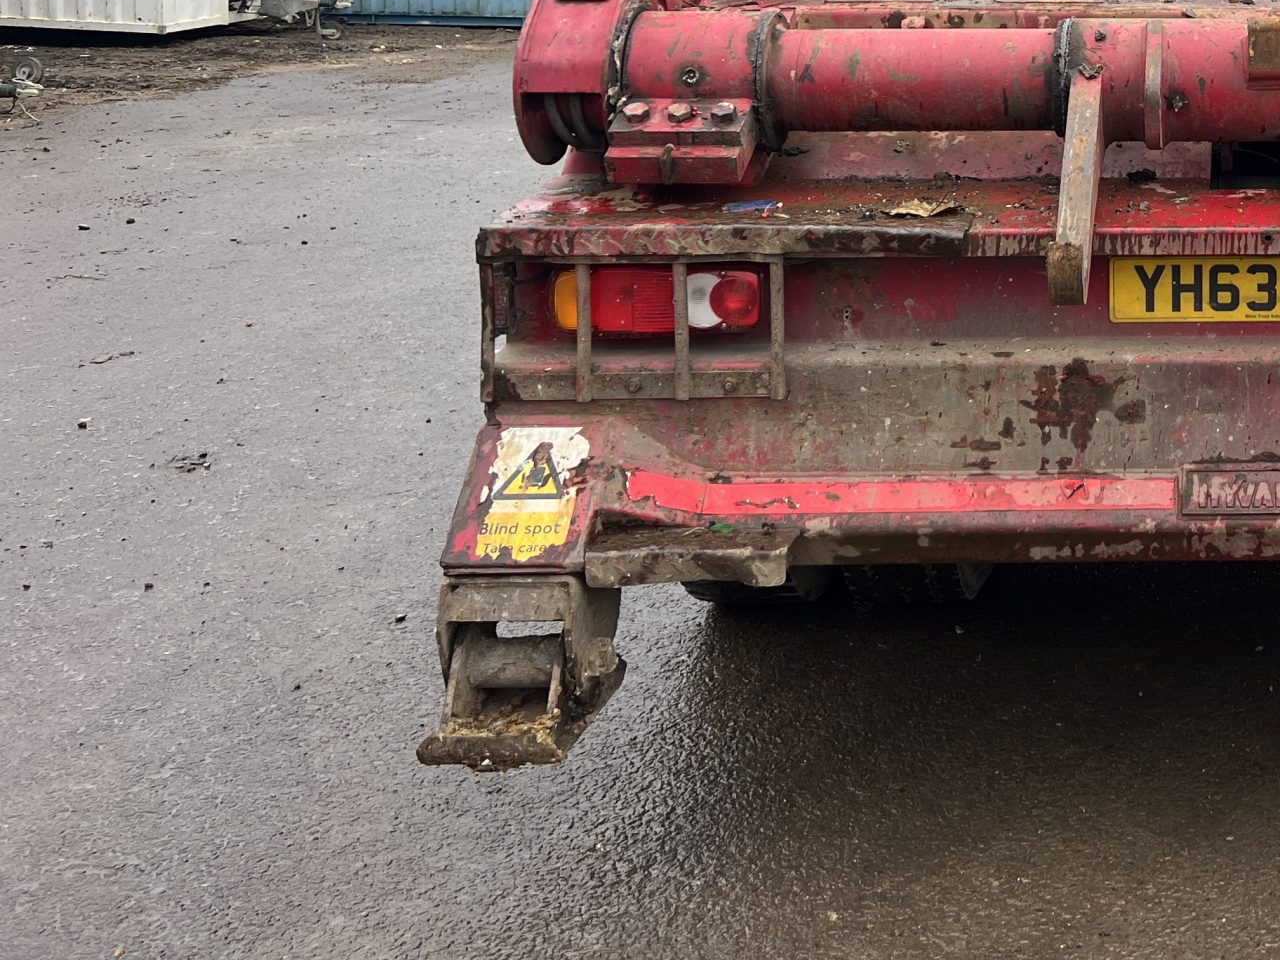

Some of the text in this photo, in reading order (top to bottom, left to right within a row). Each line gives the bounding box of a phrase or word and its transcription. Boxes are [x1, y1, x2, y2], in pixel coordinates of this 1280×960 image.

[1134, 264, 1278, 312] YH63
[479, 523, 562, 537] Blind spot
[519, 543, 547, 554] care
